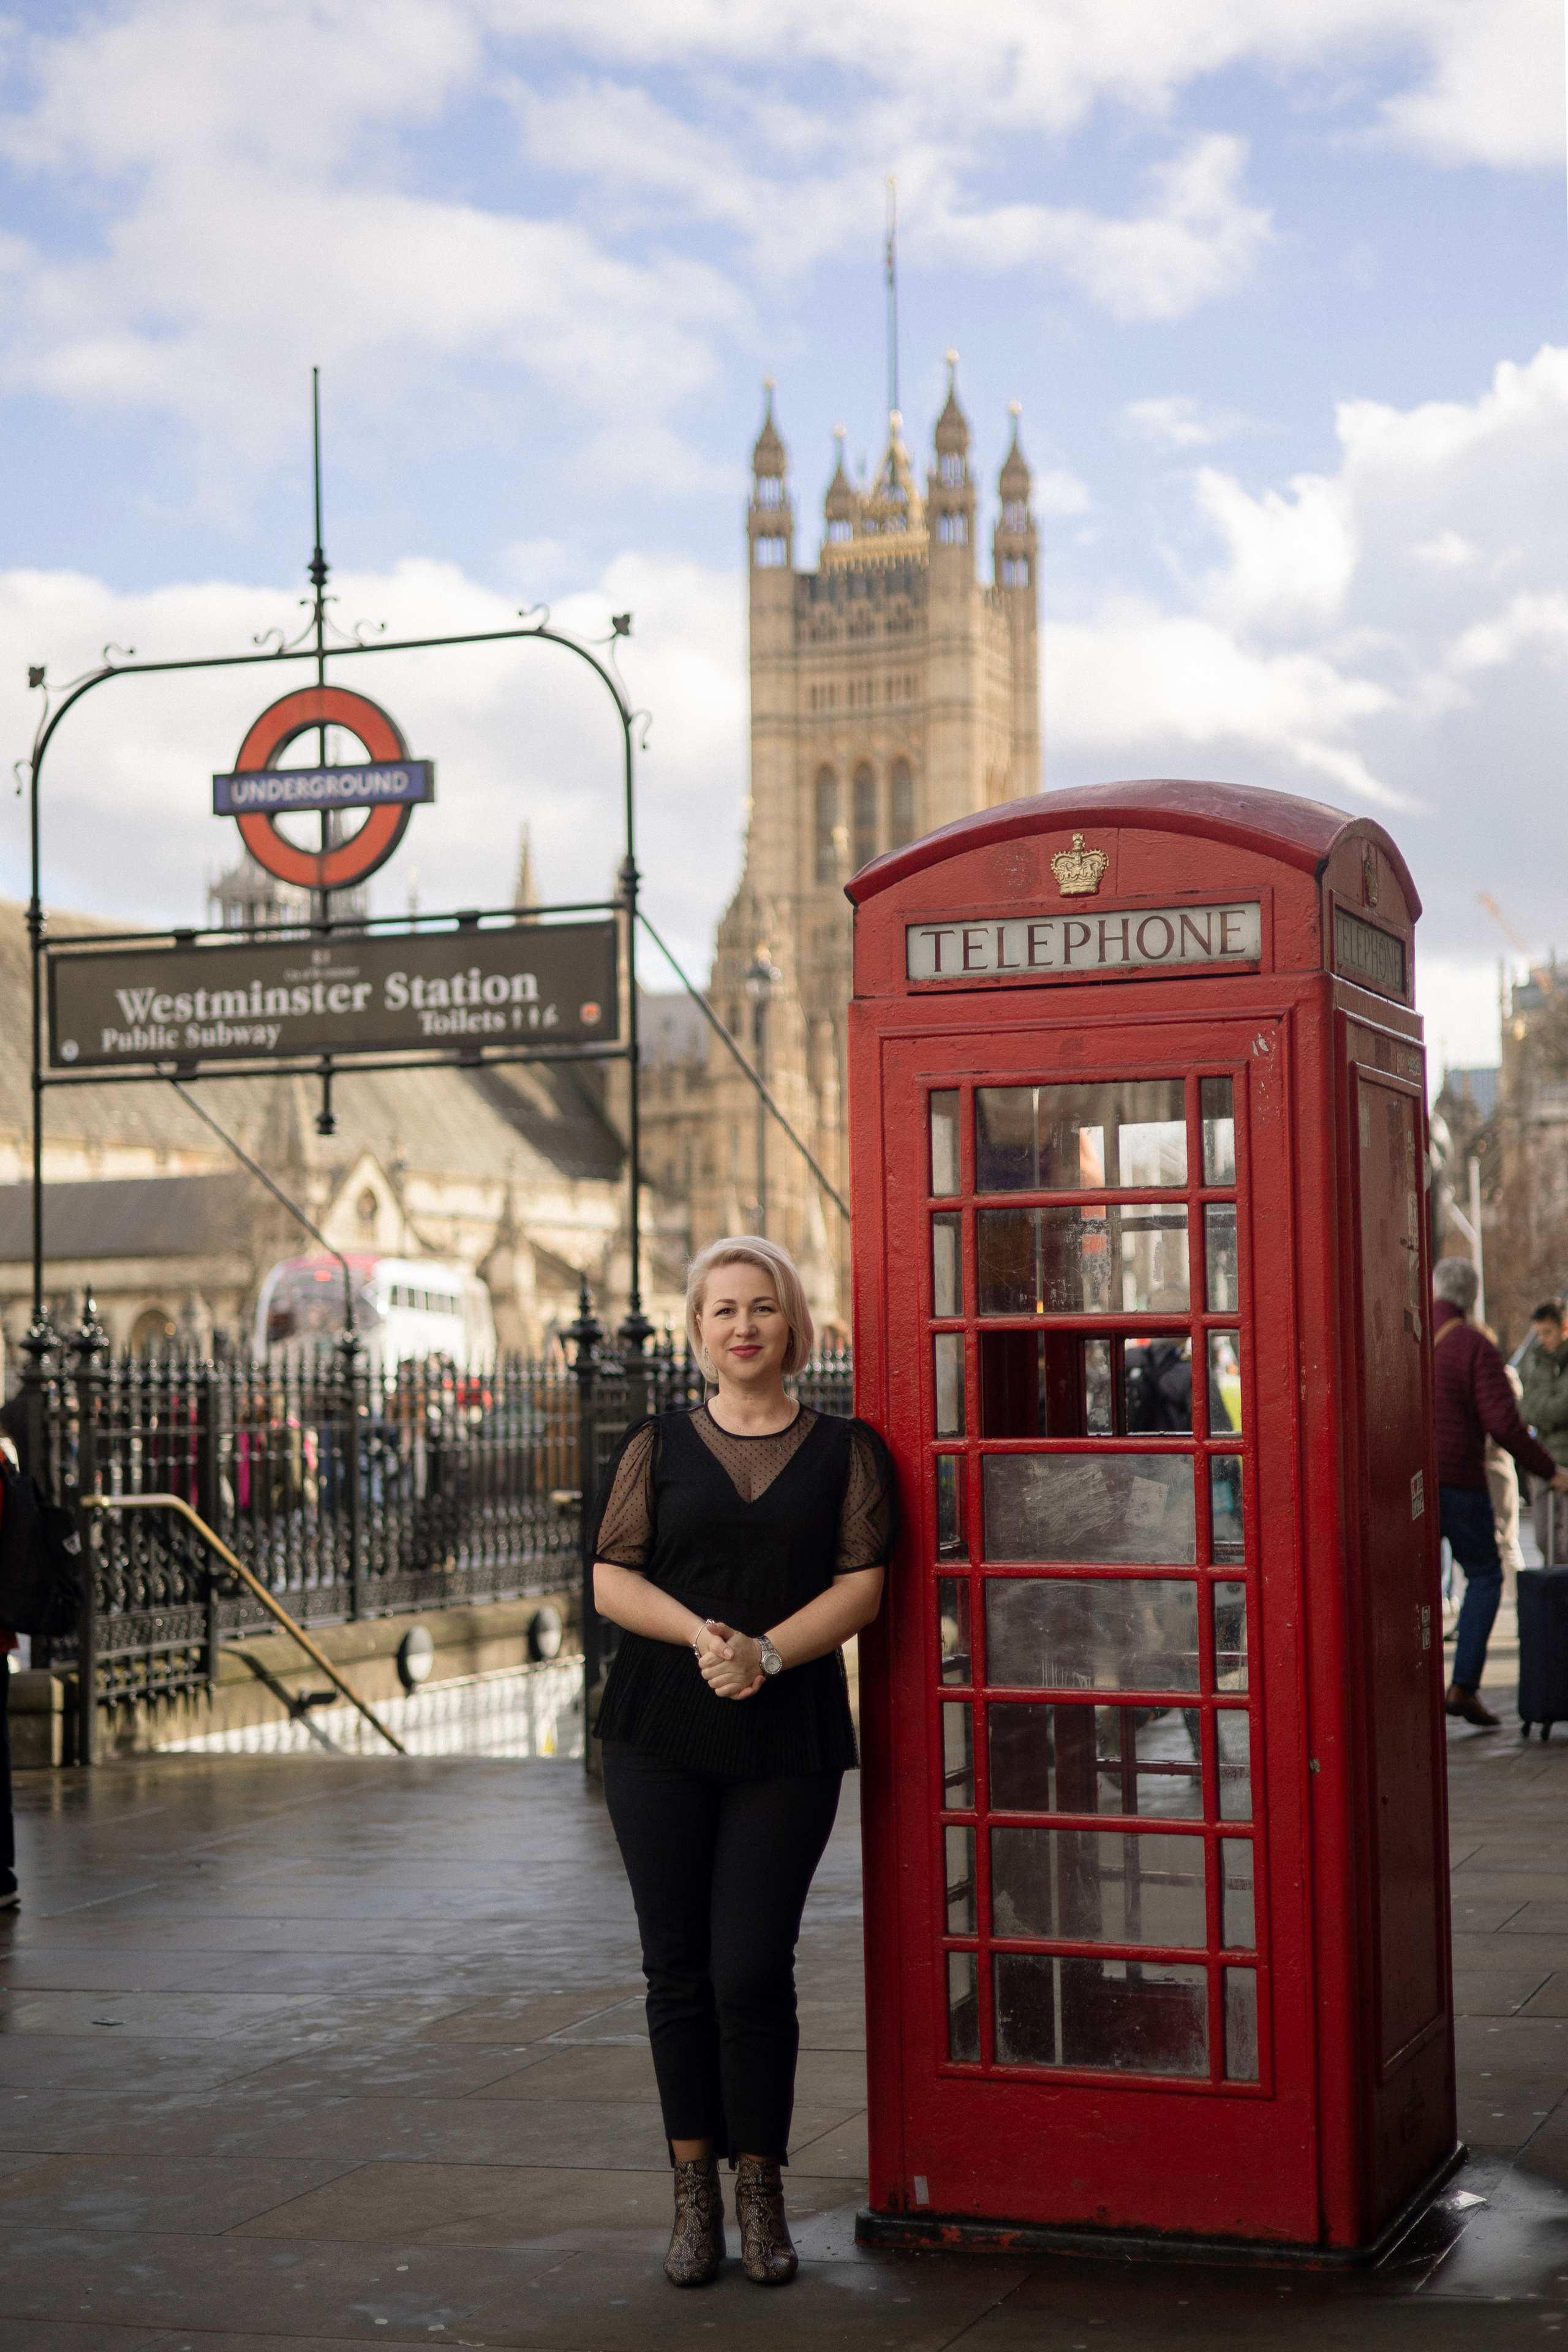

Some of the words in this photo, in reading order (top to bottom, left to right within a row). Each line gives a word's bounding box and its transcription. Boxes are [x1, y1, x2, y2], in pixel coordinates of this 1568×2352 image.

[231, 771, 409, 804] UNDERGROUND
[919, 910, 1246, 973] TELEPHONE
[1335, 915, 1400, 987] TELEPHONE
[115, 980, 372, 1025] Westminster
[384, 967, 540, 1011] Station
[101, 1024, 179, 1053] Public
[184, 1021, 282, 1050] Subway
[419, 1008, 507, 1036] Toilets
